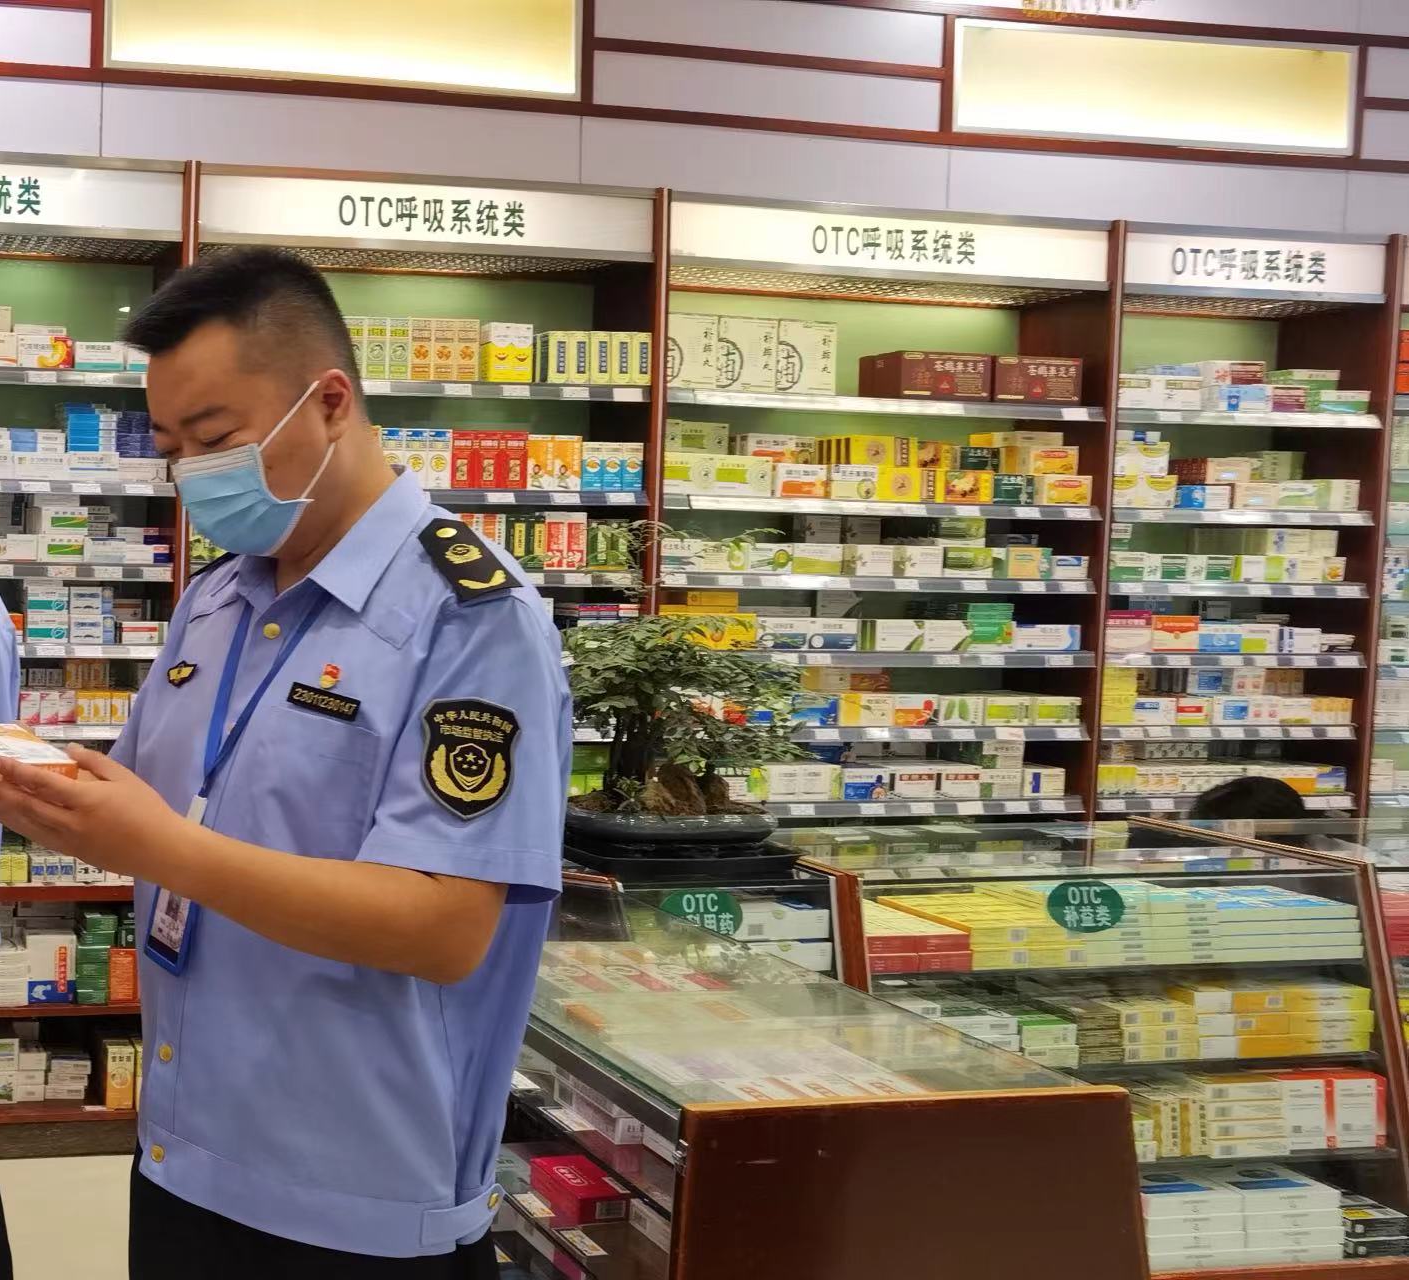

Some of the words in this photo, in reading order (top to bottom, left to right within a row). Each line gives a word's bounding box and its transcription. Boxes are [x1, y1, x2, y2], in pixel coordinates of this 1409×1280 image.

[338, 194, 527, 238] OTC呼吸系统类
[811, 224, 976, 265] OTC呼吸系统类
[1171, 247, 1327, 284] OTC呼吸系统类
[433, 709, 514, 734] 中华人民共和国
[682, 893, 719, 913] OTC
[1068, 886, 1102, 905] OTC
[1063, 905, 1112, 928] 补益类
